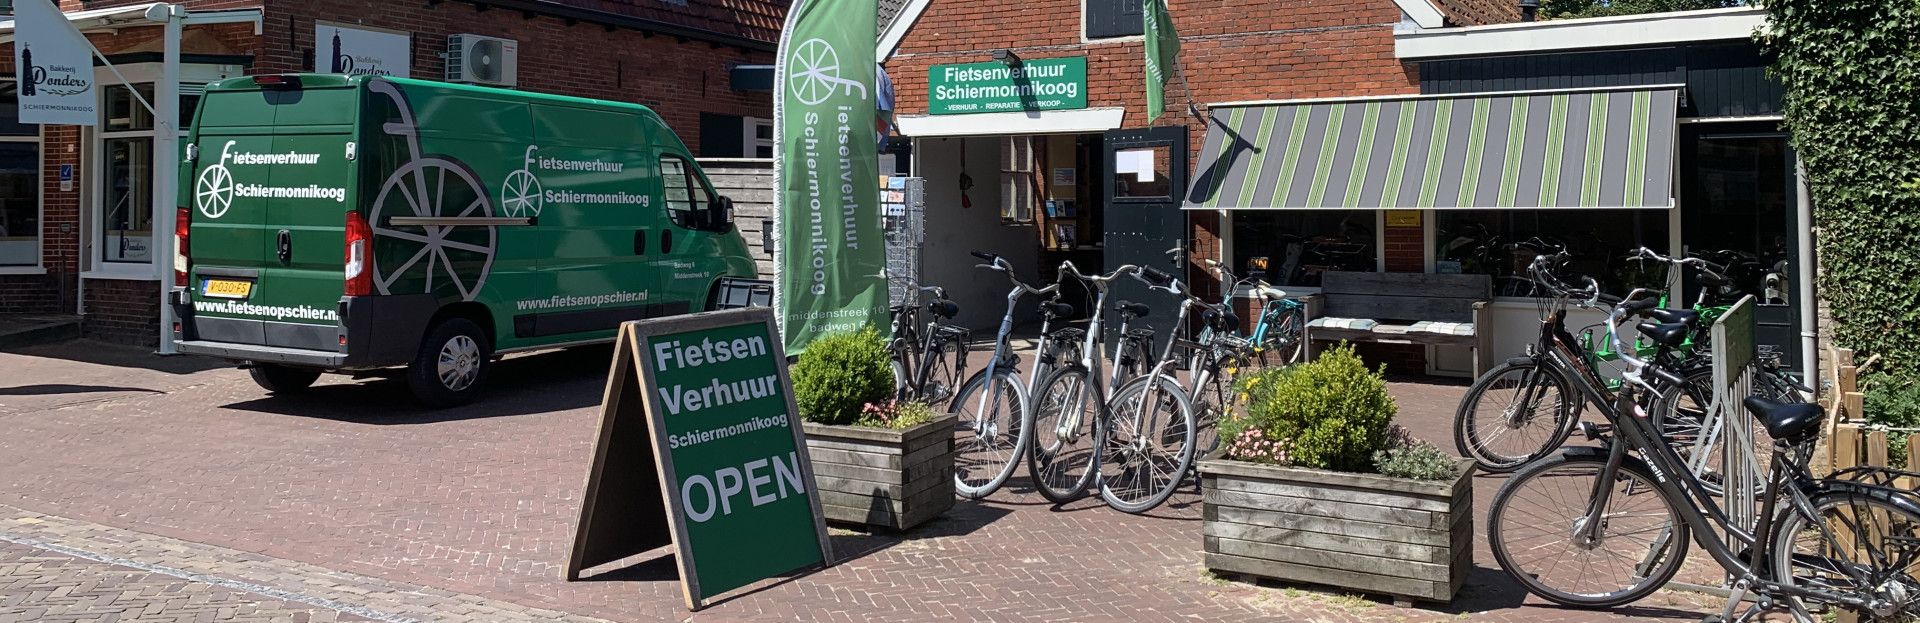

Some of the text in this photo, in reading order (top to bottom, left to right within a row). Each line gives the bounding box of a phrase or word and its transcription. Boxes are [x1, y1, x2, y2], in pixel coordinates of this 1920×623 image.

[32, 65, 86, 88] Donders
[49, 65, 76, 74] Bakkerij
[945, 63, 1067, 83] Fietsenverhuur
[935, 80, 1078, 101] Schiermonnikoog
[23, 103, 94, 113] SCHIERMONNIKOOG
[948, 100, 1061, 112] VERHUUR REPARATIE VERKOOP
[234, 182, 346, 202] Schiermonnikoog
[545, 188, 650, 208] Schiermonnikoog
[804, 111, 829, 295] Schiermonnikoog
[194, 300, 339, 321] www.fietsenopschier.n
[517, 289, 648, 311] www.fietsenopschier.nl
[788, 305, 885, 322] middenstreek 10
[809, 321, 856, 333] badweg
[654, 335, 766, 372] Fietsen
[659, 374, 778, 415] Verhuur
[669, 413, 789, 449] Schiermonnikoog
[1638, 447, 1667, 484] Gazelle
[681, 451, 806, 523] OPEN
